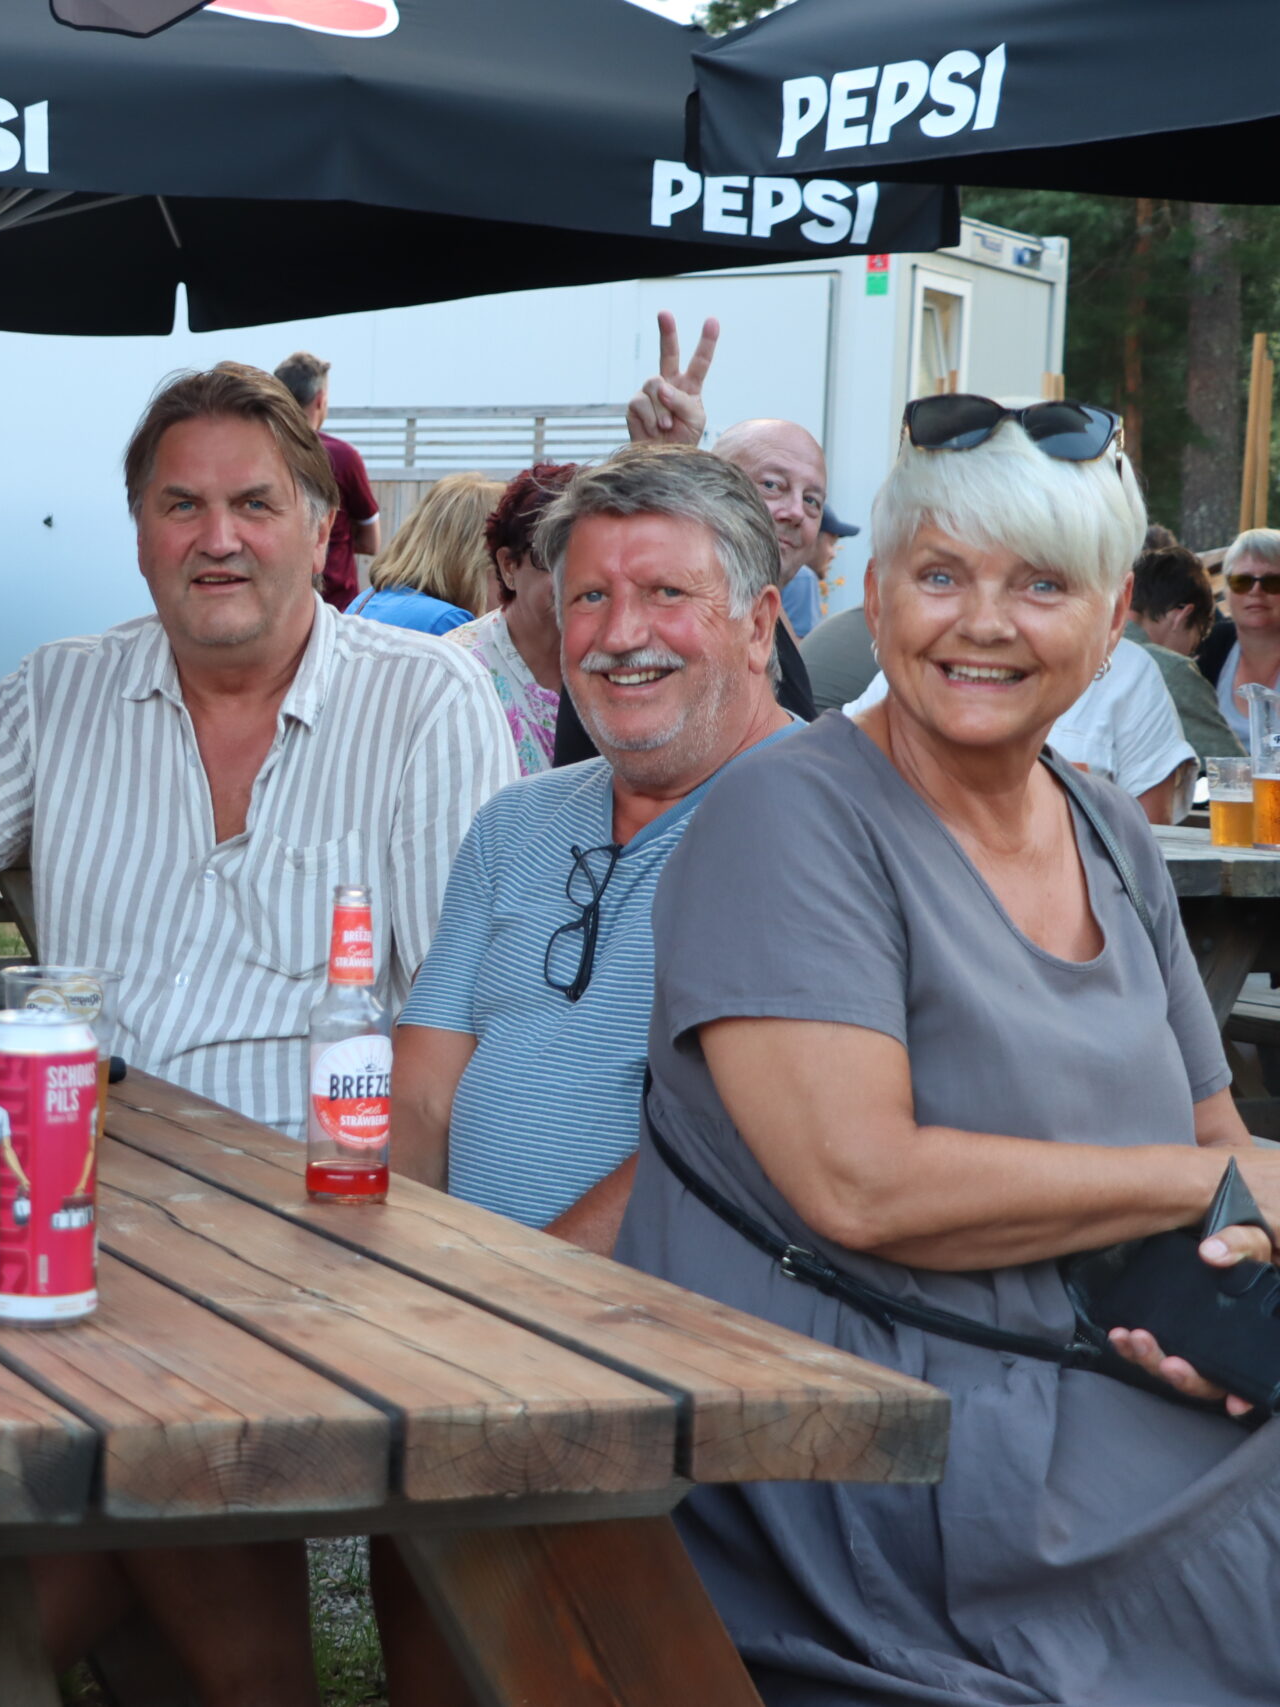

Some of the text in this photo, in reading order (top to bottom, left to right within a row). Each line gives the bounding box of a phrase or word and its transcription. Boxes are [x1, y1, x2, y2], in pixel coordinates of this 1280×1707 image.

[777, 43, 1006, 158] PEPSI
[651, 159, 878, 245] PEPSI
[46, 1088, 80, 1113] PILS
[47, 1062, 97, 1089] SCHOUS
